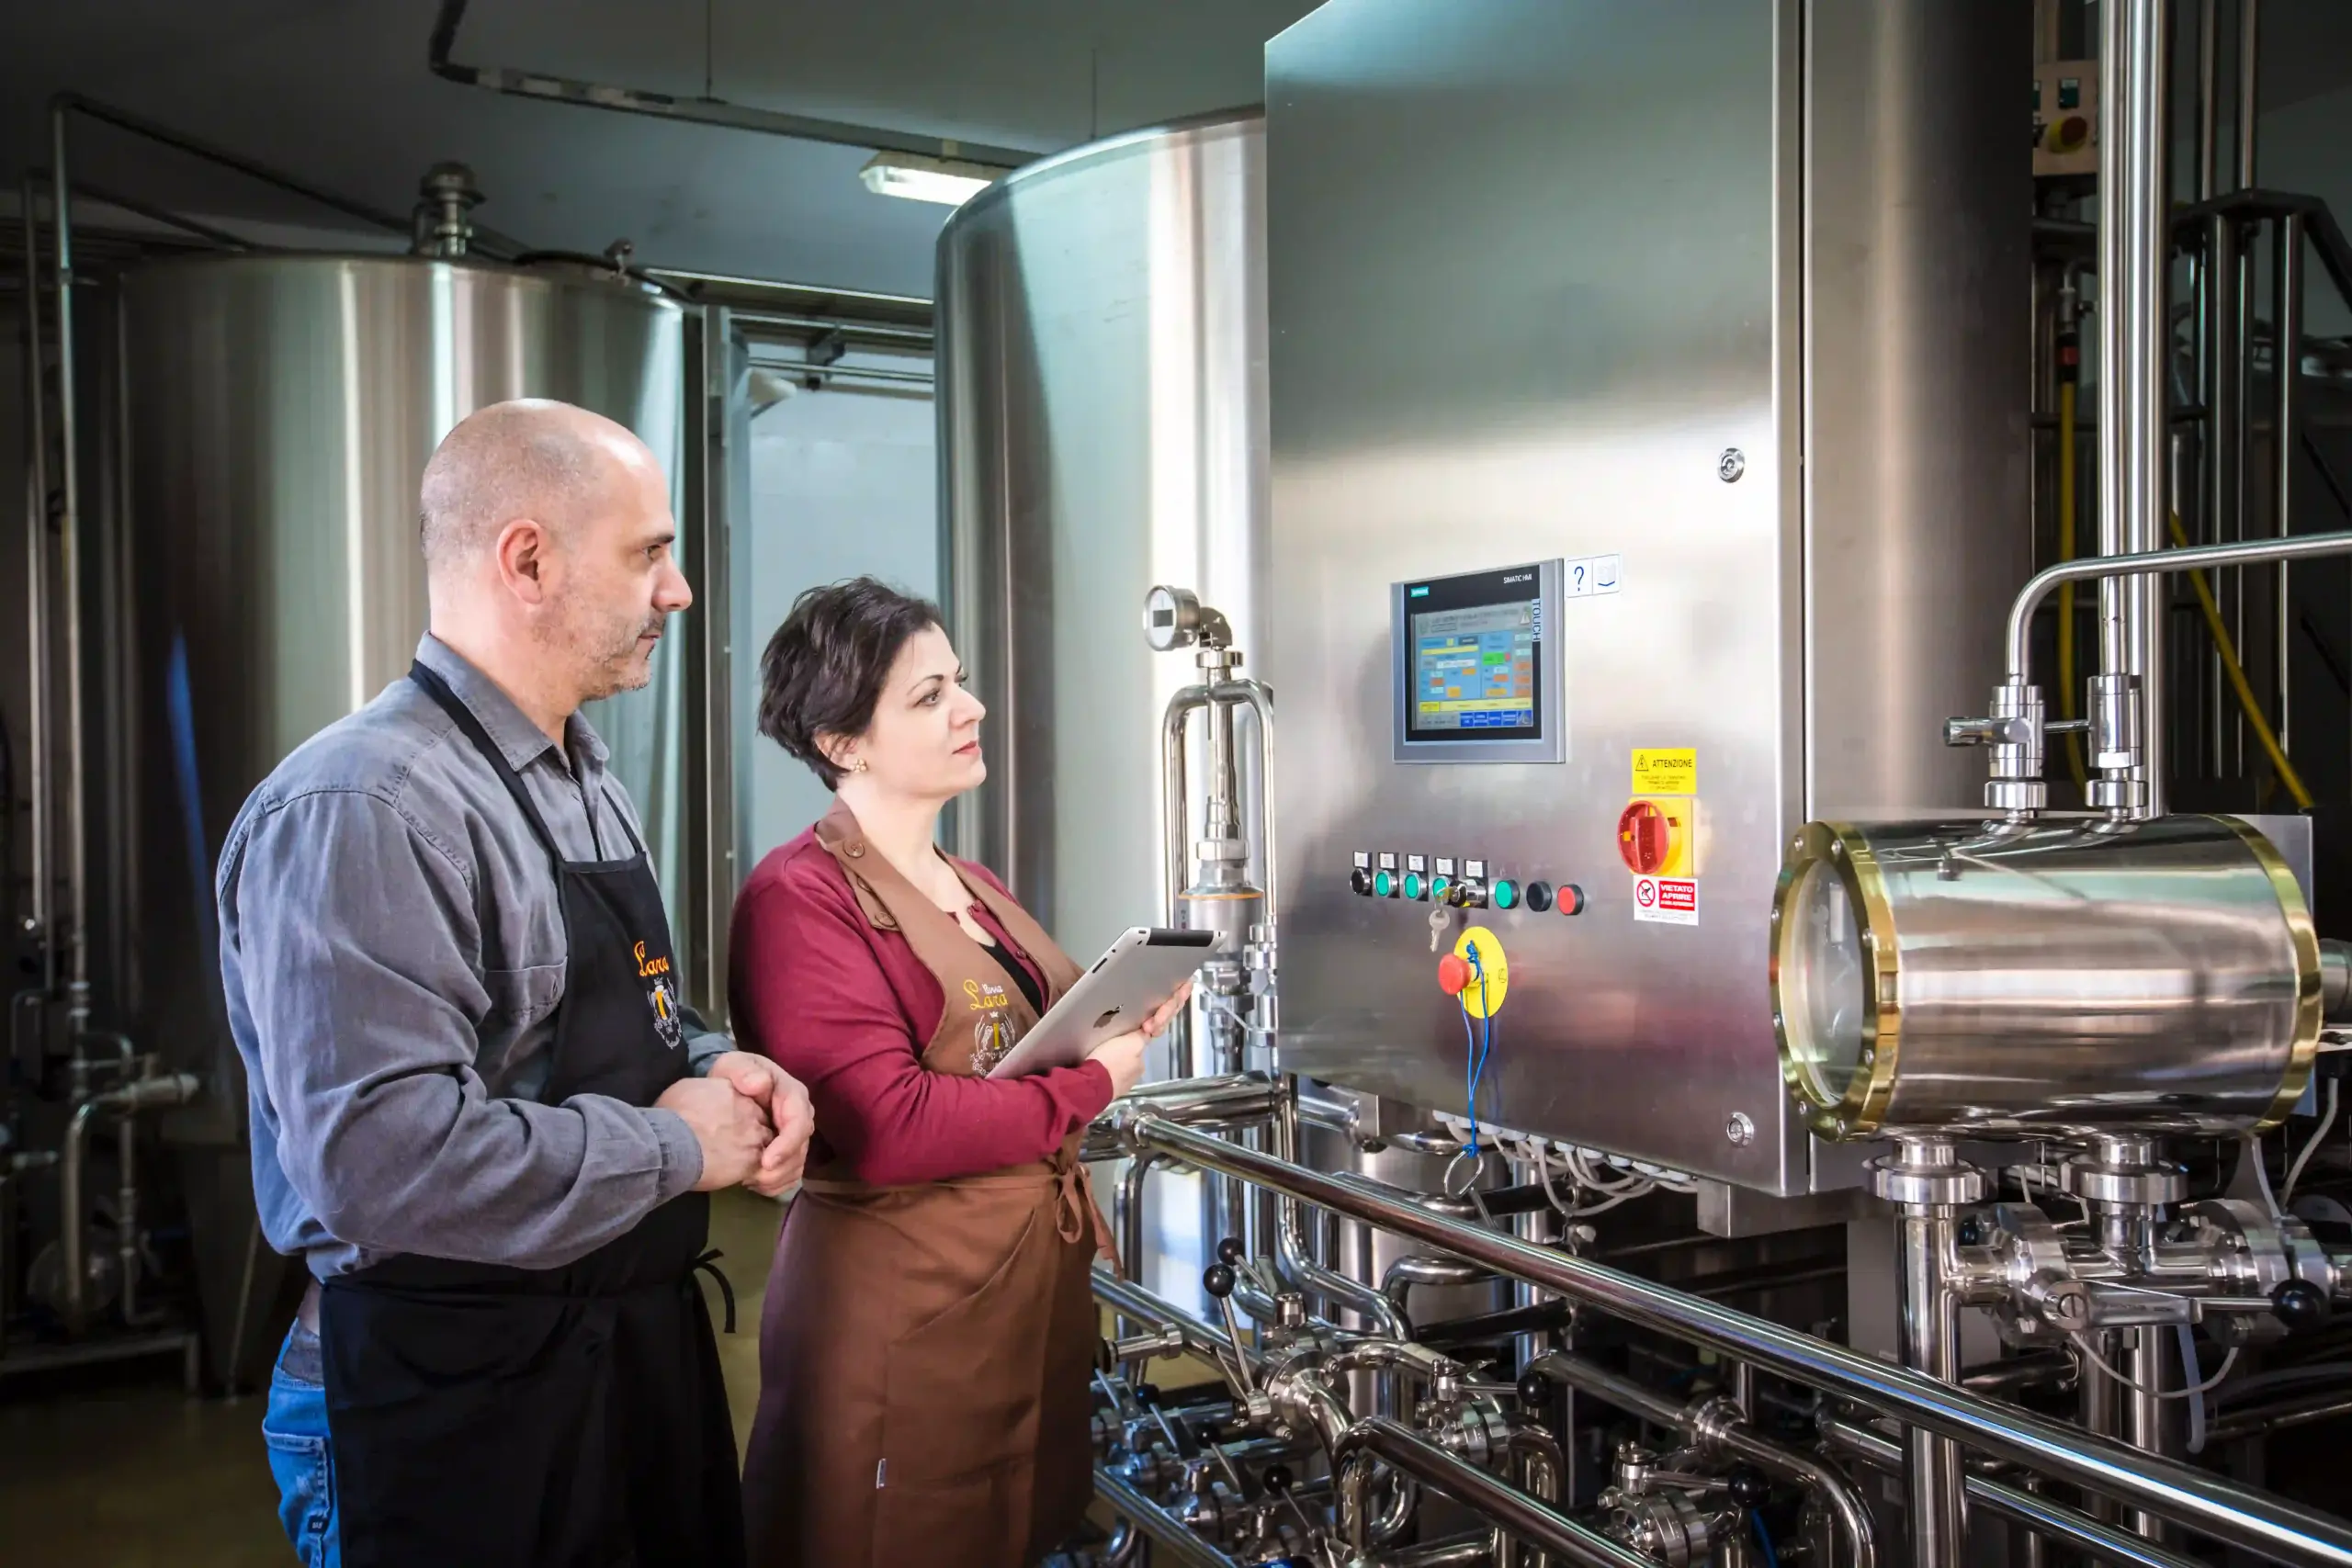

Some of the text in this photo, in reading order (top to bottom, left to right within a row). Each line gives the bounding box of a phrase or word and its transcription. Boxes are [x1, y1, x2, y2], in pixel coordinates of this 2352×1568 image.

[1503, 574, 1522, 583] SIMATIC
[1532, 600, 1541, 641] TOUCH
[1652, 759, 1692, 768] ATTENZIONE
[1659, 884, 1694, 893] VIETATO
[1661, 892, 1692, 901] APRIRE
[963, 978, 1009, 1010] Lara
